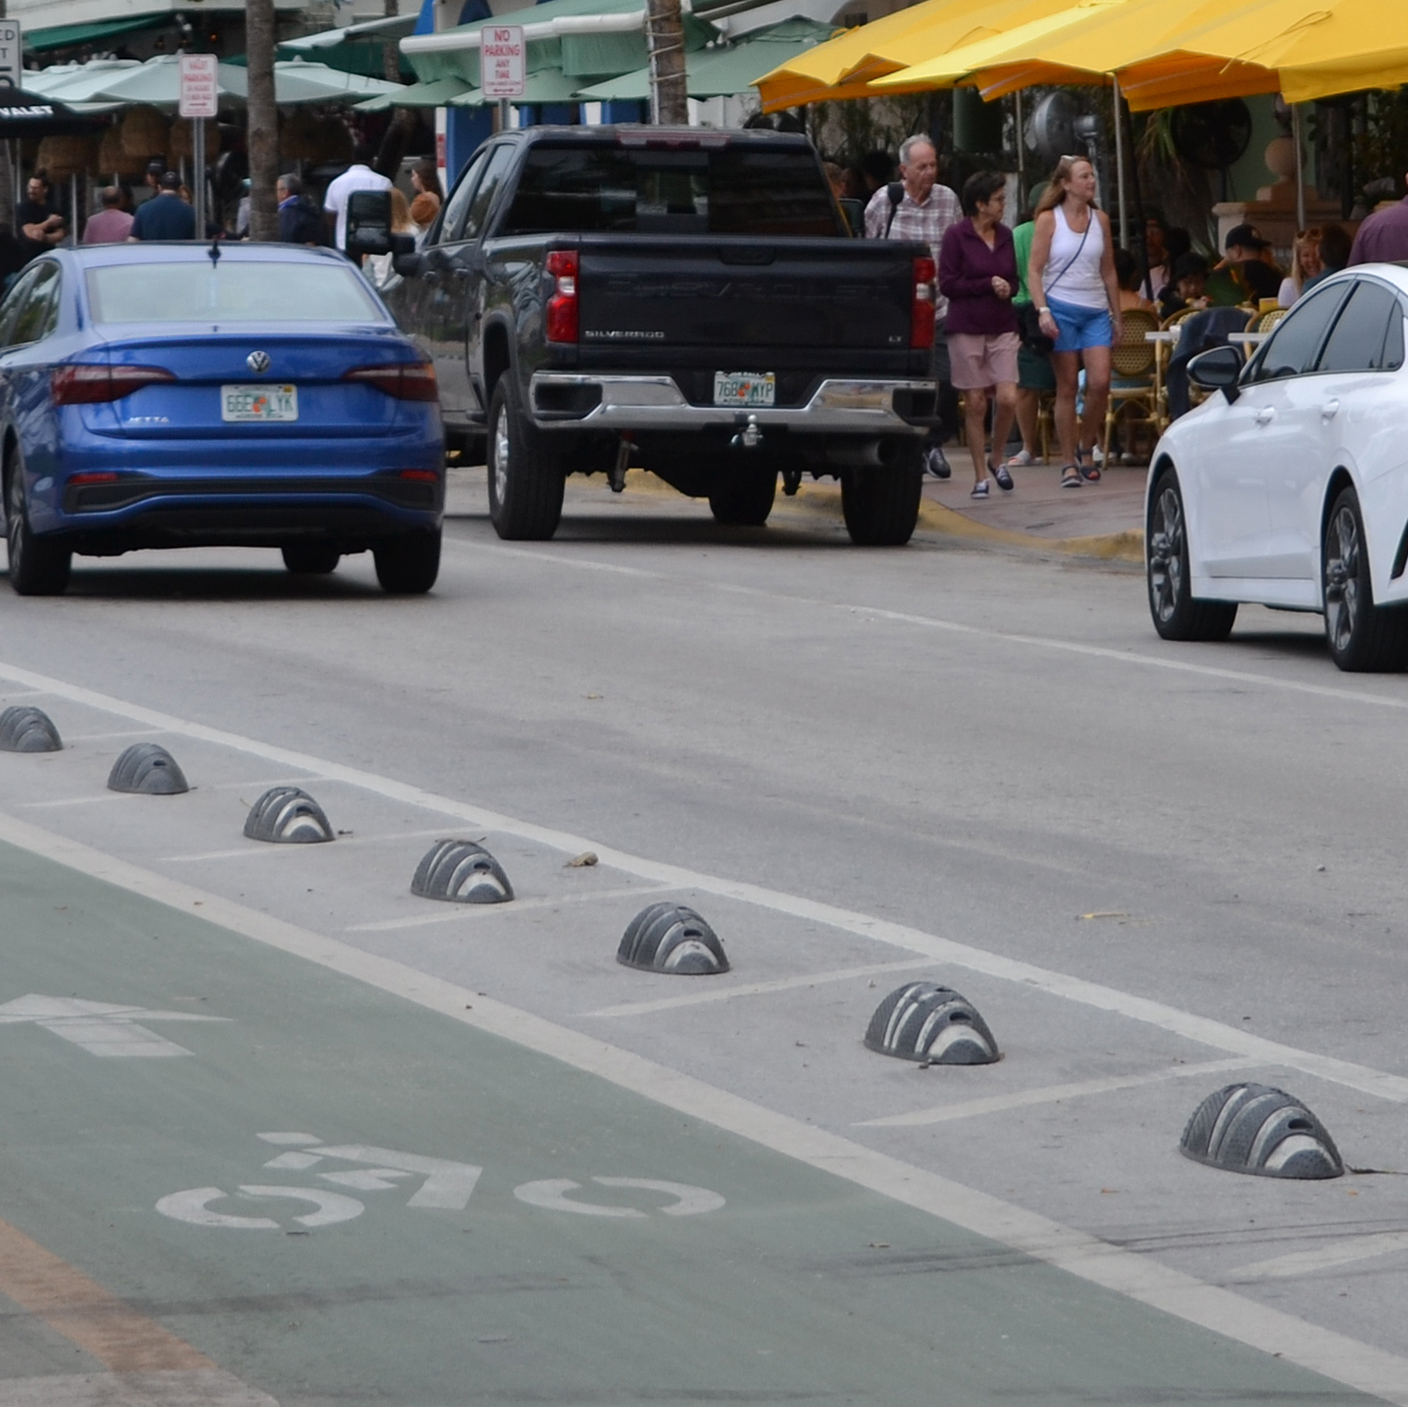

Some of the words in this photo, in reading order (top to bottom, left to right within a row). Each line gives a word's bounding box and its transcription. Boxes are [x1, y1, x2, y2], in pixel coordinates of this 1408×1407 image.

[494, 29, 510, 42] NO
[484, 44, 520, 56] PARKING
[585, 330, 665, 339] SILVERADO
[129, 416, 170, 424] JETTA
